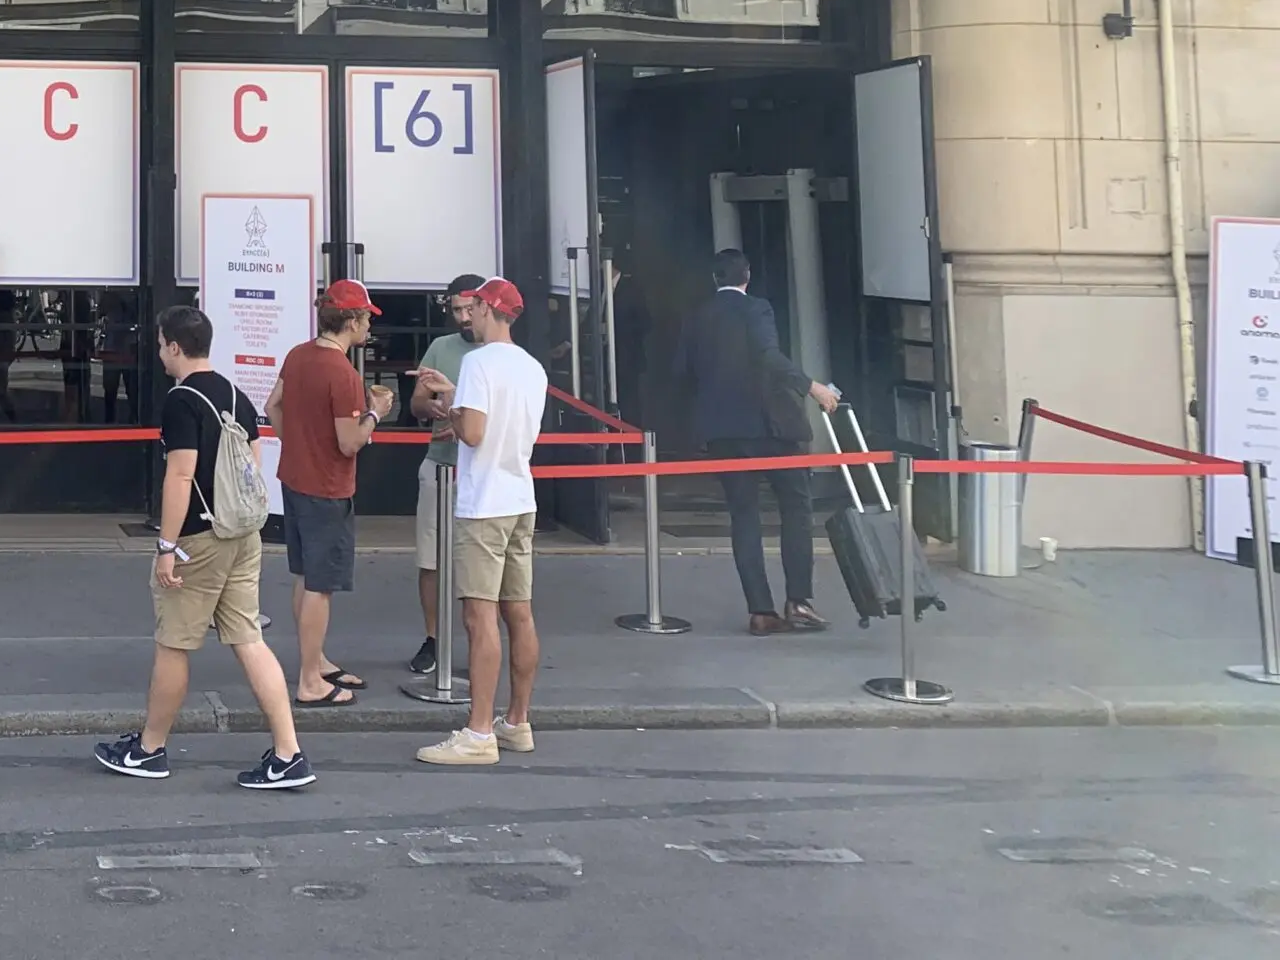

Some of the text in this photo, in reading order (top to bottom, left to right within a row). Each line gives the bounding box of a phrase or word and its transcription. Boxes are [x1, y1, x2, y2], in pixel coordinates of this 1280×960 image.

[43, 81, 79, 141] C
[233, 84, 268, 143] C
[374, 81, 473, 154] [6]
[228, 261, 285, 273] BUILDING M
